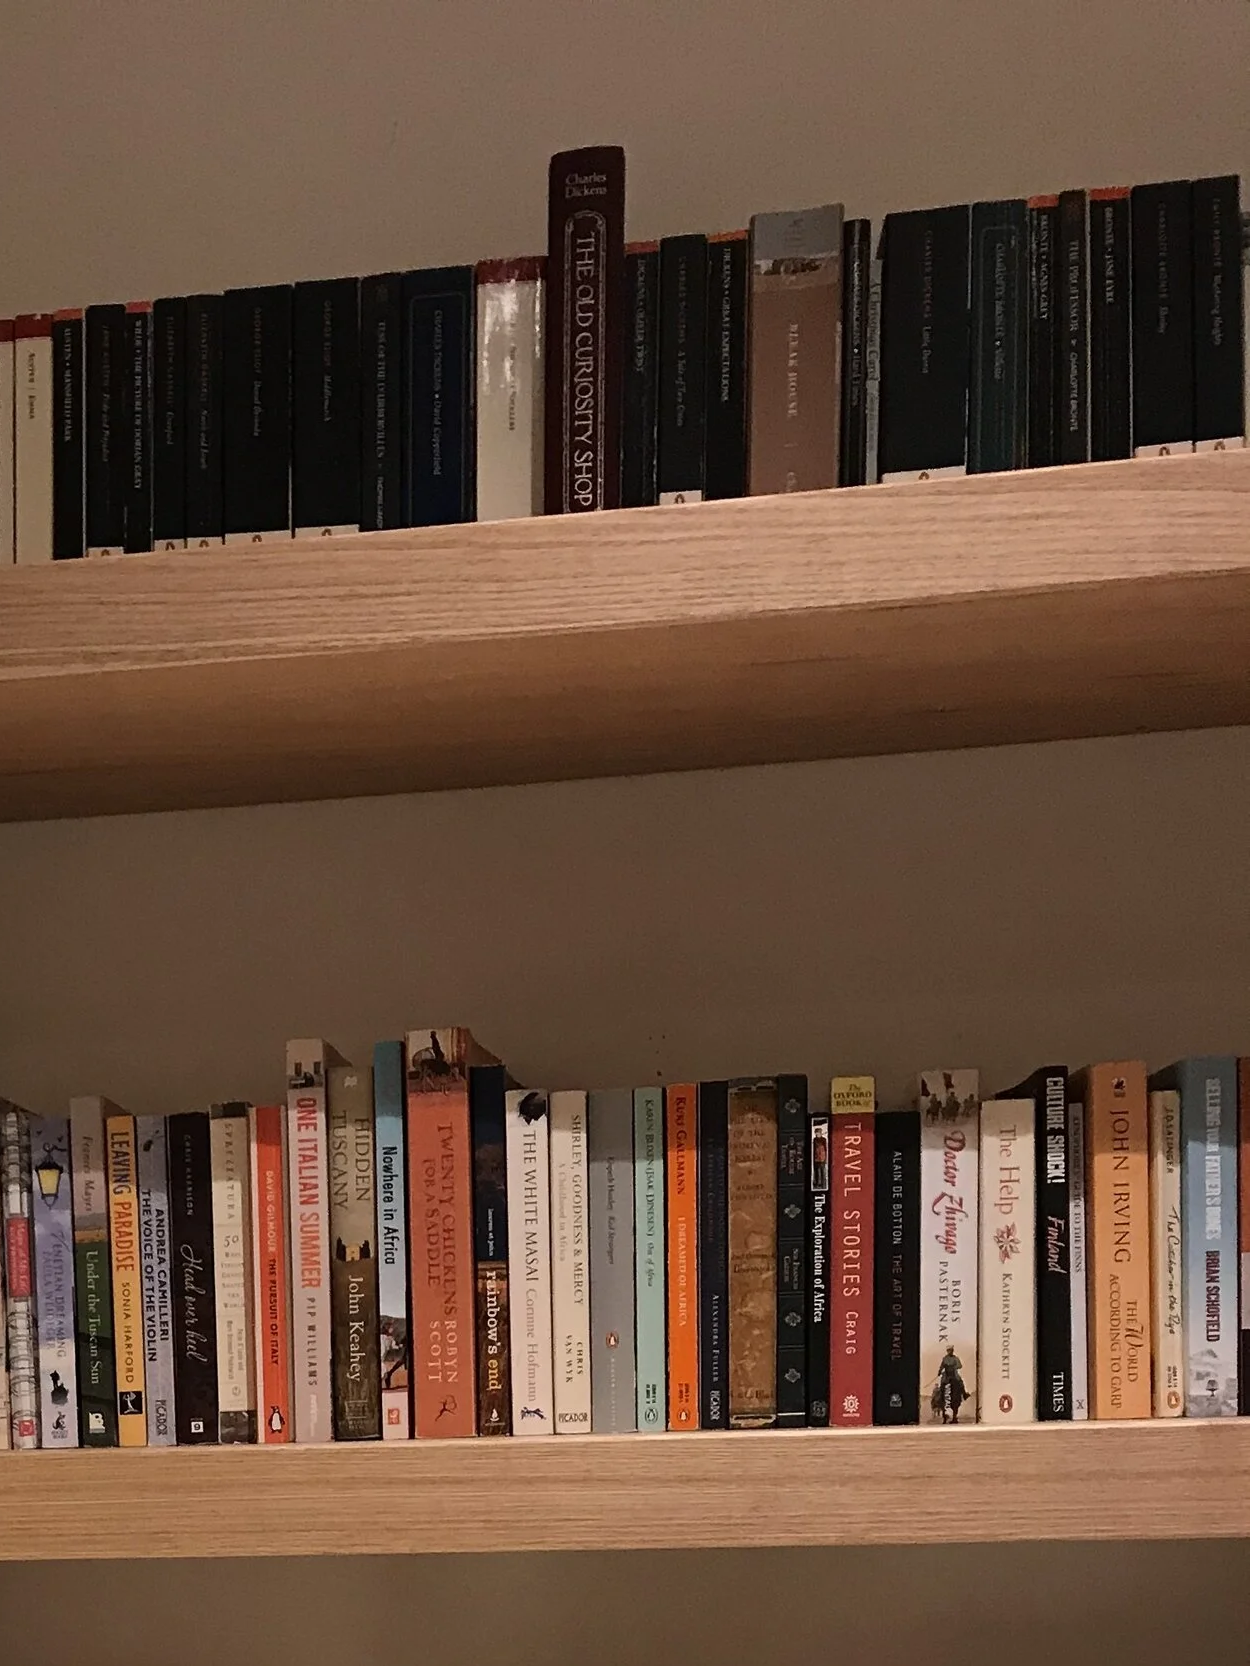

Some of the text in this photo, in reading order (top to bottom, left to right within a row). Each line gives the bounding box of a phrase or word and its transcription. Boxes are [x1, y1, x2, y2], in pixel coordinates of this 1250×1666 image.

[1070, 240, 1078, 261] THE
[573, 232, 597, 507] THE OLD CURIOSITY SHOP
[296, 1097, 322, 1289] ONE ITALIAN SUMMER
[383, 1146, 399, 1265] Nowhere in Africa
[521, 1130, 540, 1282] THE WHITE MASAI
[842, 1123, 862, 1197] TRAVEL
[995, 1124, 1021, 1215] The Help
[1110, 1109, 1132, 1264] JOHN IRVING
[84, 1250, 103, 1384] Under the Tuscan Sun
[110, 1132, 137, 1383] LEAVING PARADISE SONIA HARFORD
[156, 1208, 170, 1342] ANDREA CAMILLERI
[811, 1193, 826, 1322] The Exploration of Africa
[842, 1210, 861, 1297] STORIES
[1045, 1215, 1067, 1412] Finland TIMES
[345, 1275, 365, 1382] John Keahey
[485, 1271, 504, 1390] rainbow's end
